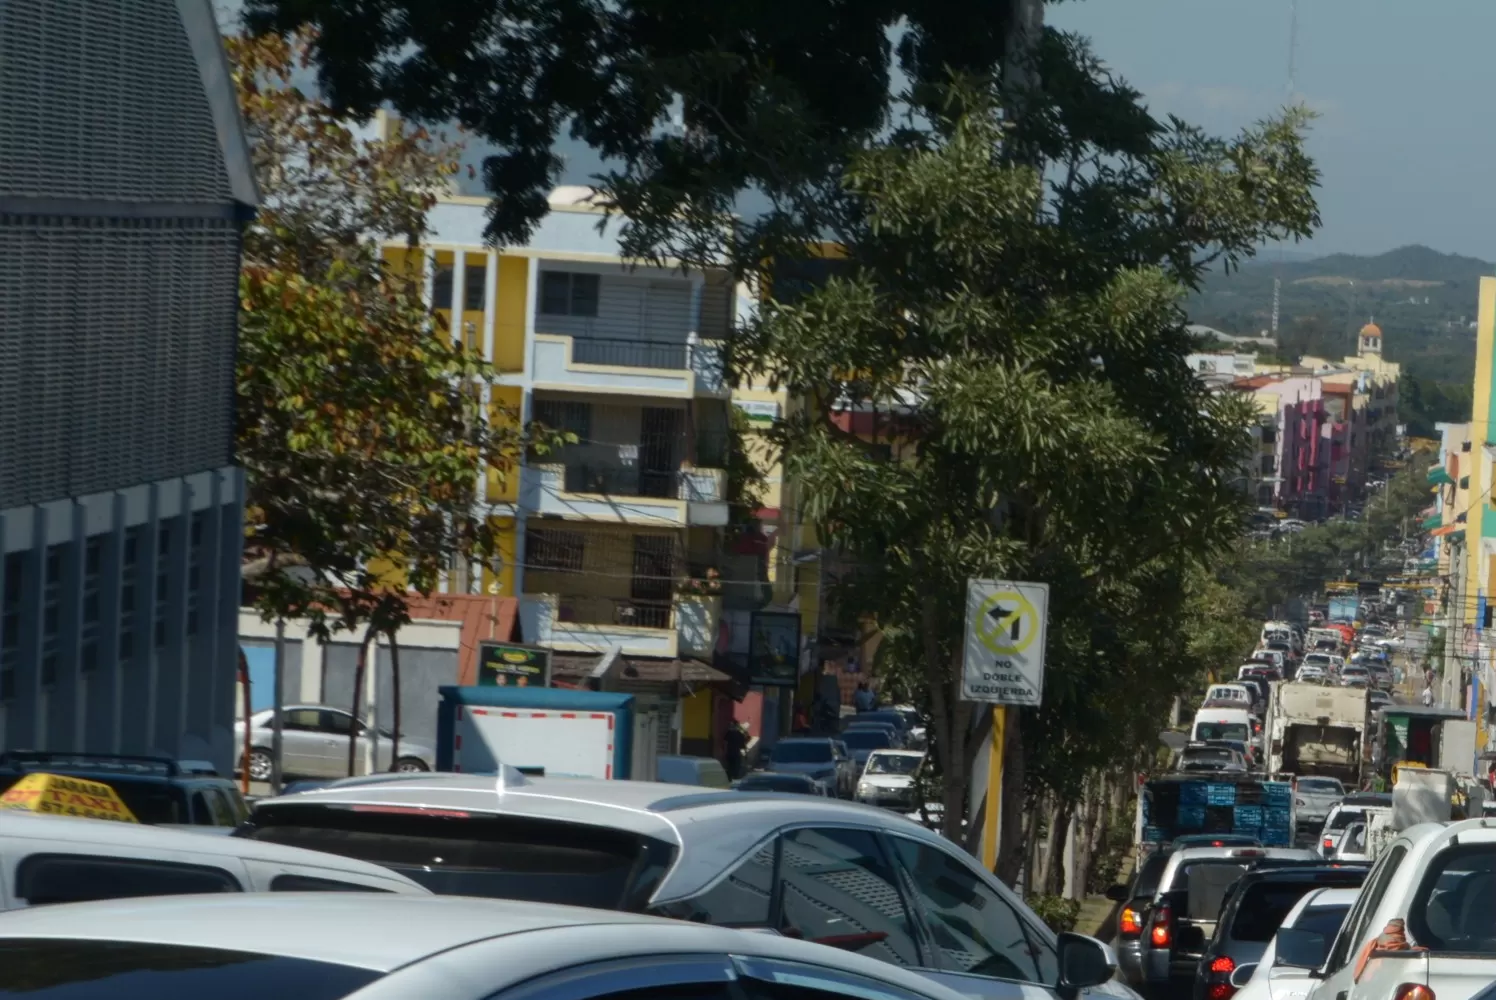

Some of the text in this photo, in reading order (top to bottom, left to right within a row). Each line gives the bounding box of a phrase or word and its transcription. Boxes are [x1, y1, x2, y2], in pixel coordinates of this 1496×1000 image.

[995, 660, 1012, 669] NO
[983, 672, 1022, 683] DOBLE
[970, 684, 1034, 697] IZQUIERDA
[46, 788, 121, 812] TAXI
